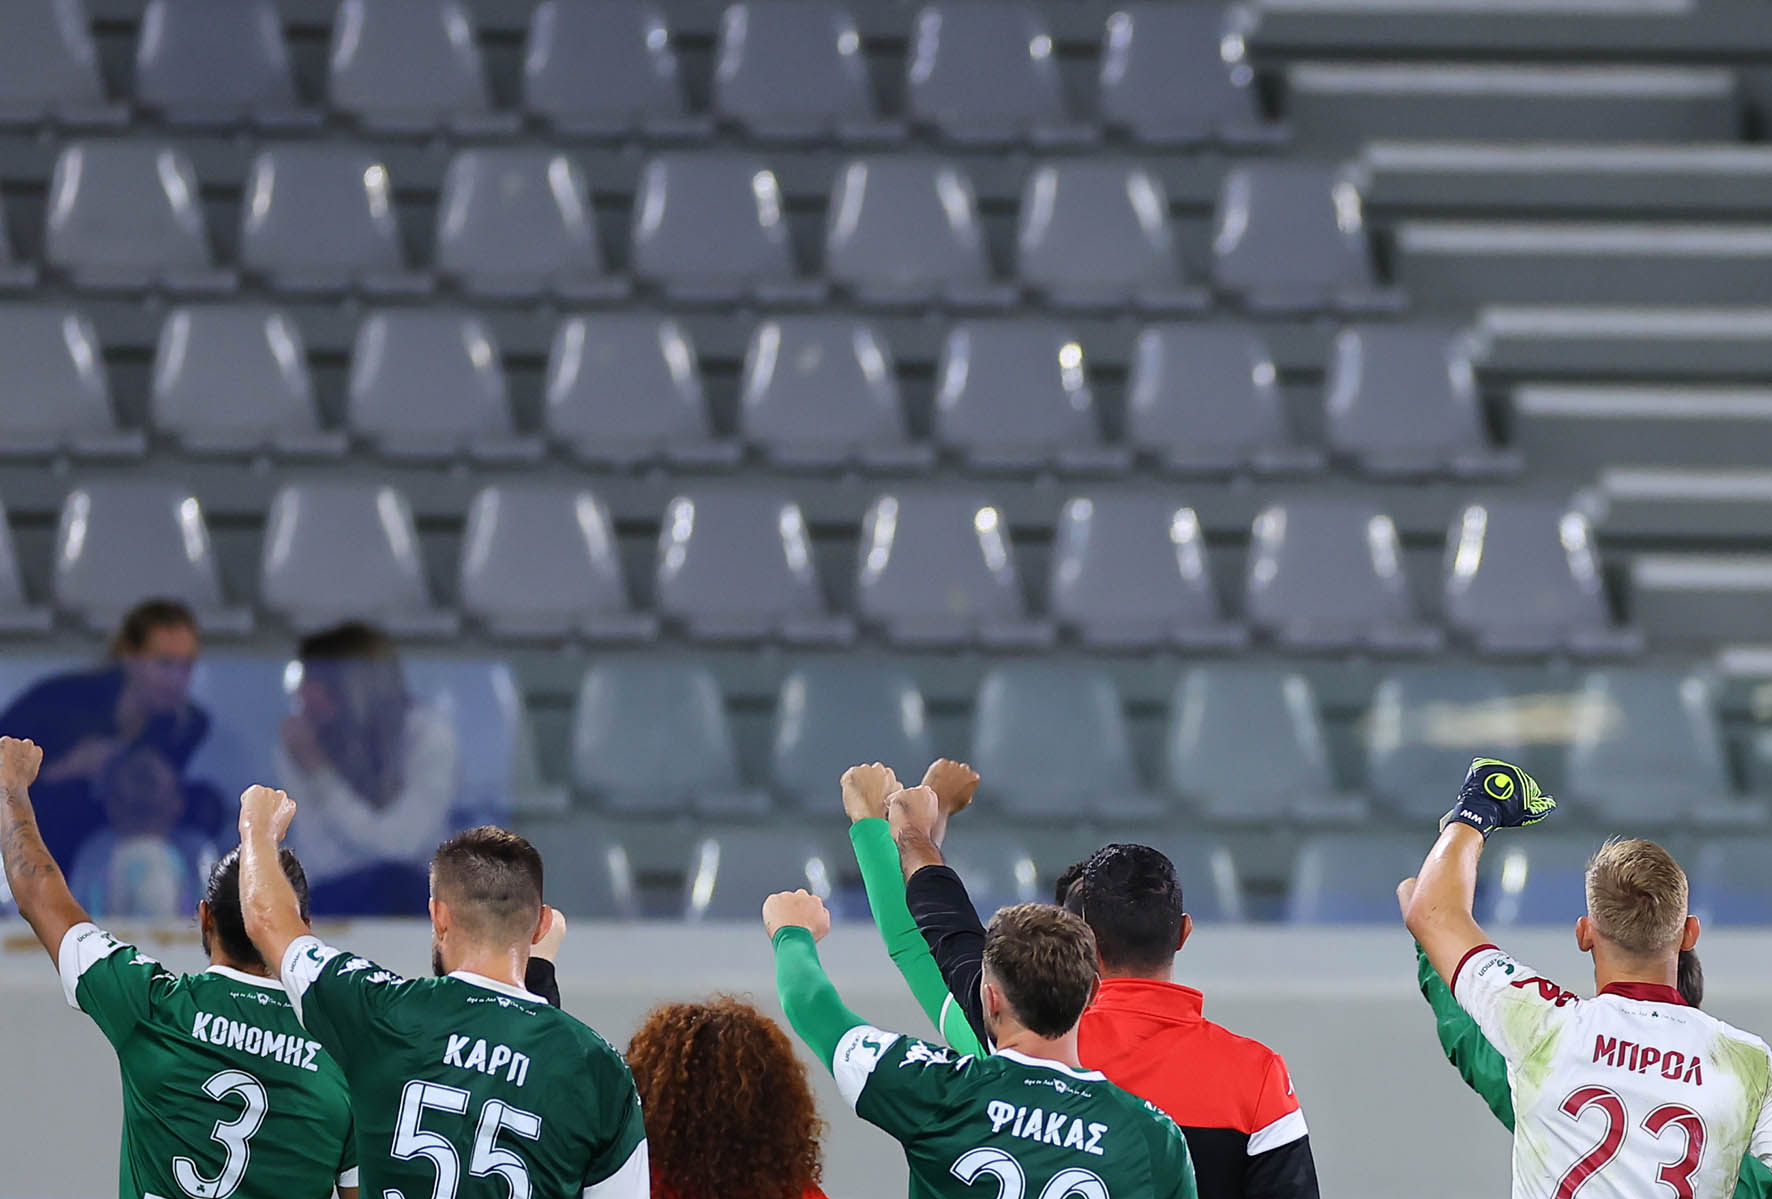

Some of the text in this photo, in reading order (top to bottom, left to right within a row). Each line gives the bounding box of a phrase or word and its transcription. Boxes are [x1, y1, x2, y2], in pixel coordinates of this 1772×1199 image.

[191, 1011, 323, 1072] ΚΟΝΟΜΗΣ
[443, 1033, 531, 1088] ΚΑΡΠ
[1592, 1034, 1703, 1087] ΜΠΡΟΛ
[986, 1100, 1109, 1156] ΦΙΑΚΑΣ
